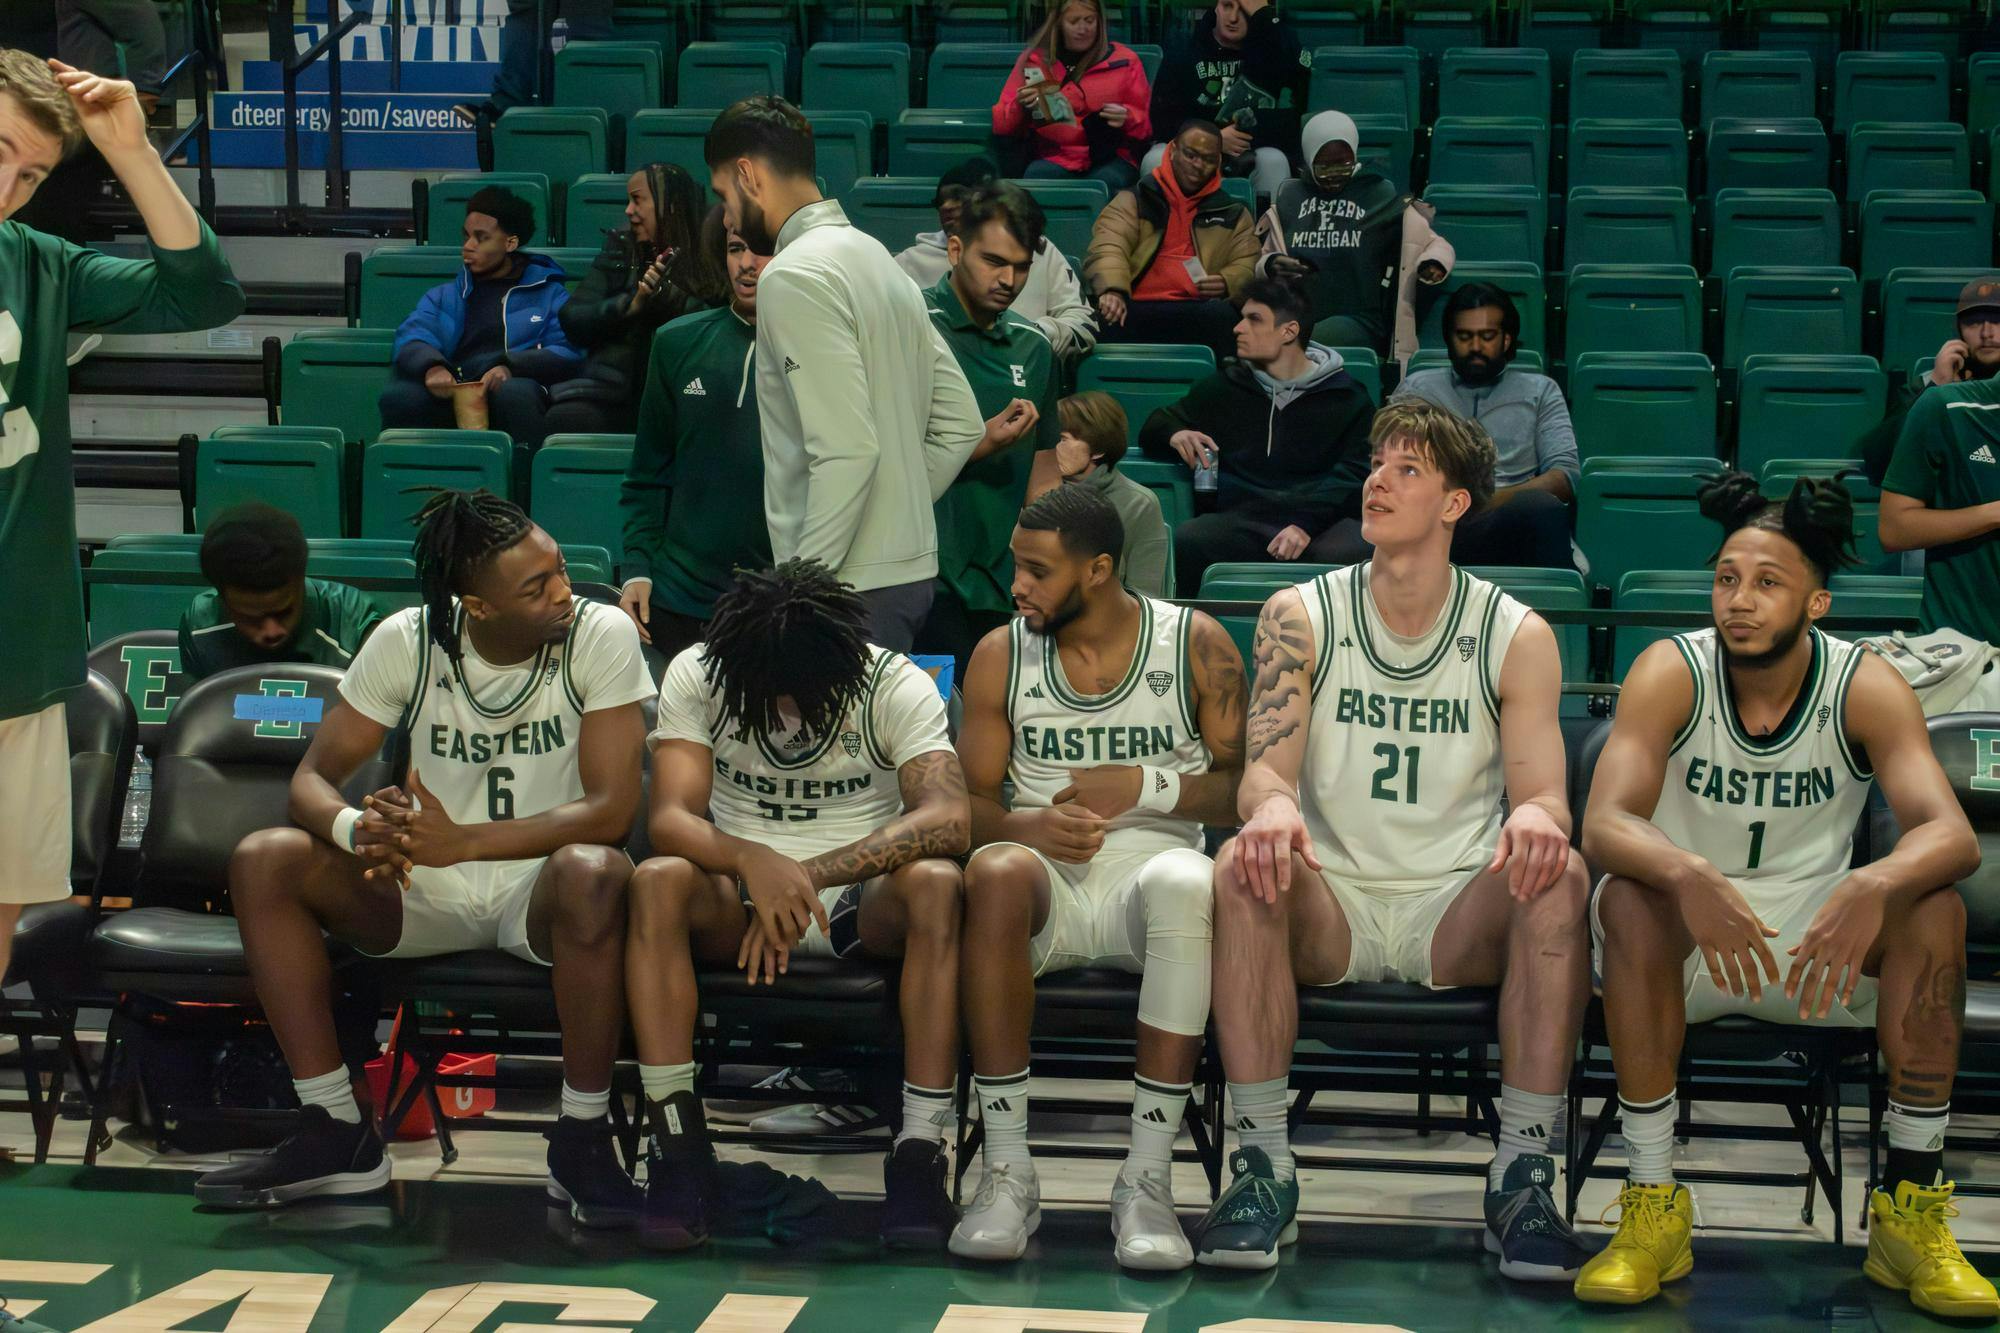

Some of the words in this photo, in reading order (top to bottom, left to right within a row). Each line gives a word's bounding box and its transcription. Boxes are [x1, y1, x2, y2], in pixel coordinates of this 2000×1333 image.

[1298, 197, 1366, 220] EASTERN
[1291, 230, 1362, 249] MICHIGAN
[1010, 364, 1026, 387] E
[120, 646, 183, 724] E
[1336, 688, 1470, 733] EASTERN
[431, 714, 566, 764] EASTERN
[1022, 725, 1174, 761] EASTERN
[487, 766, 515, 822] 6
[715, 756, 872, 799] EASTERN
[1371, 742, 1420, 804] 21
[1685, 756, 1835, 808] EASTERN
[1747, 821, 1766, 869] 1
